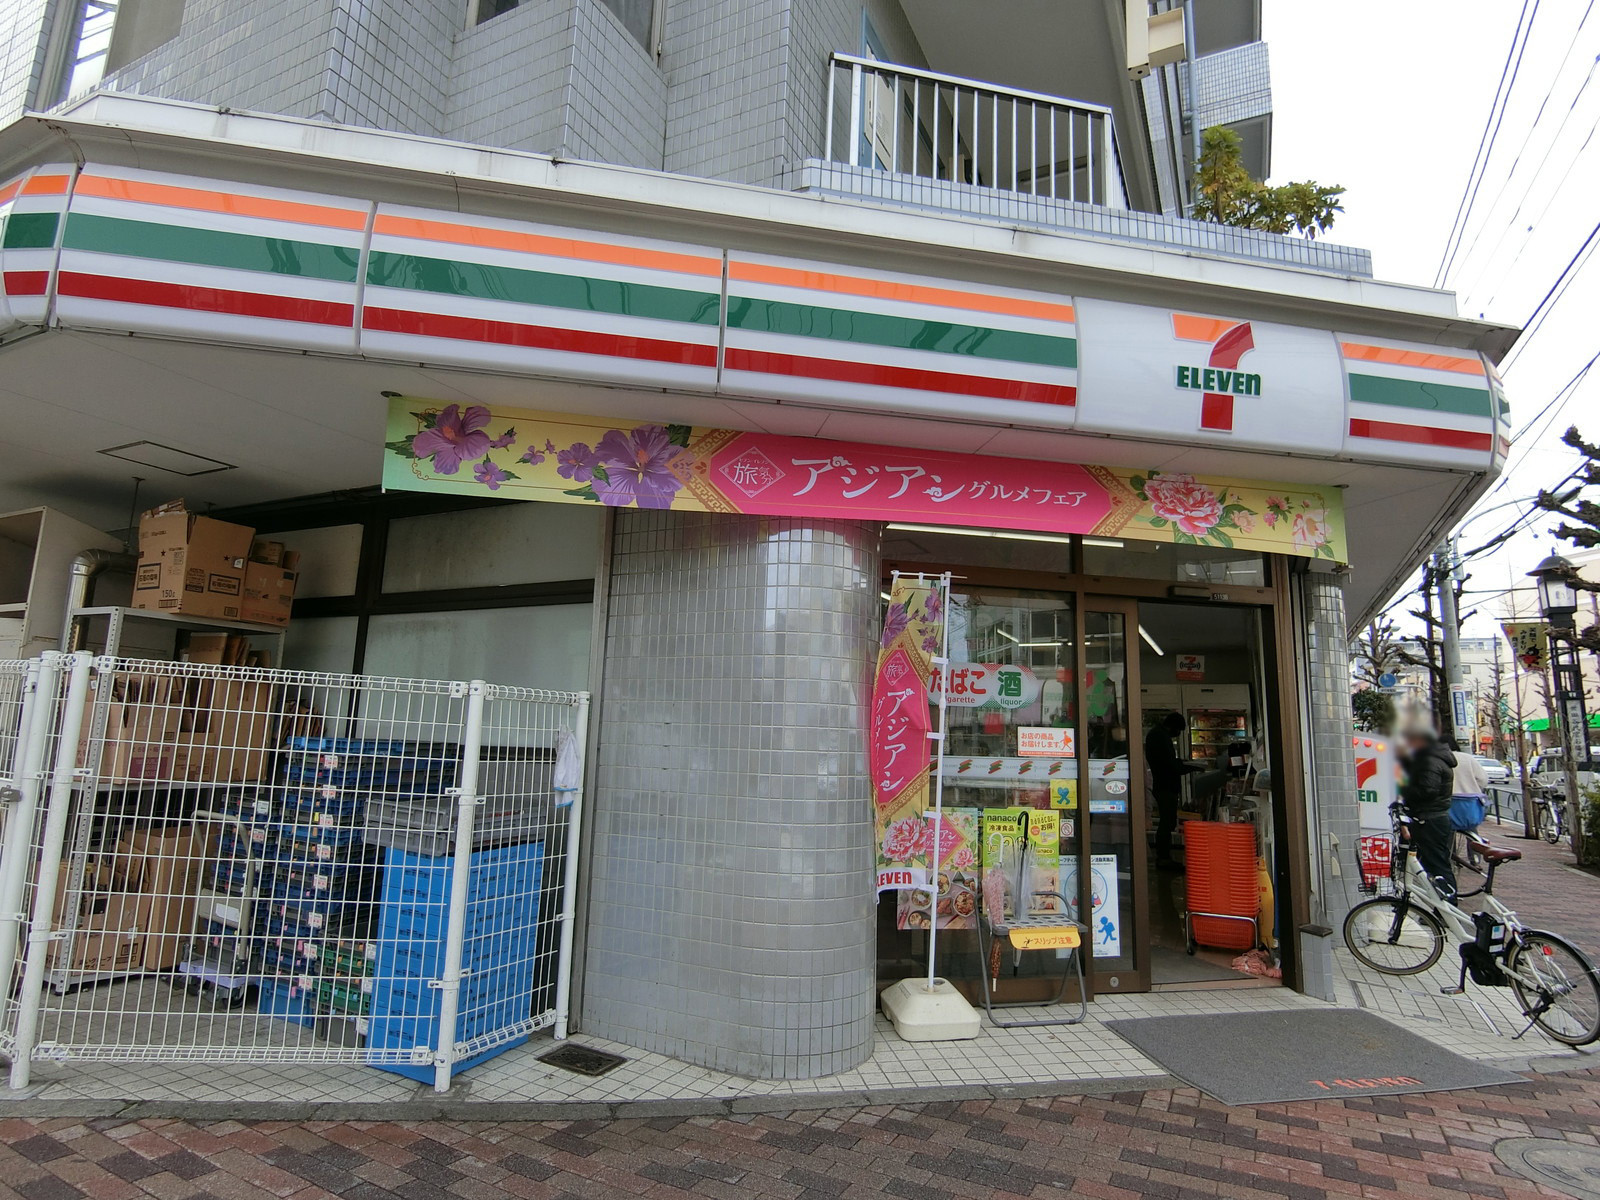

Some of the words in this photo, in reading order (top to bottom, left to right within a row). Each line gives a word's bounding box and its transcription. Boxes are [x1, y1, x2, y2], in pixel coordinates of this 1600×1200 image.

[997, 670, 1022, 697] 酒
[944, 696, 976, 704] igarette
[1000, 698, 1022, 706] liquor
[1033, 936, 1073, 945] スリップ注意
